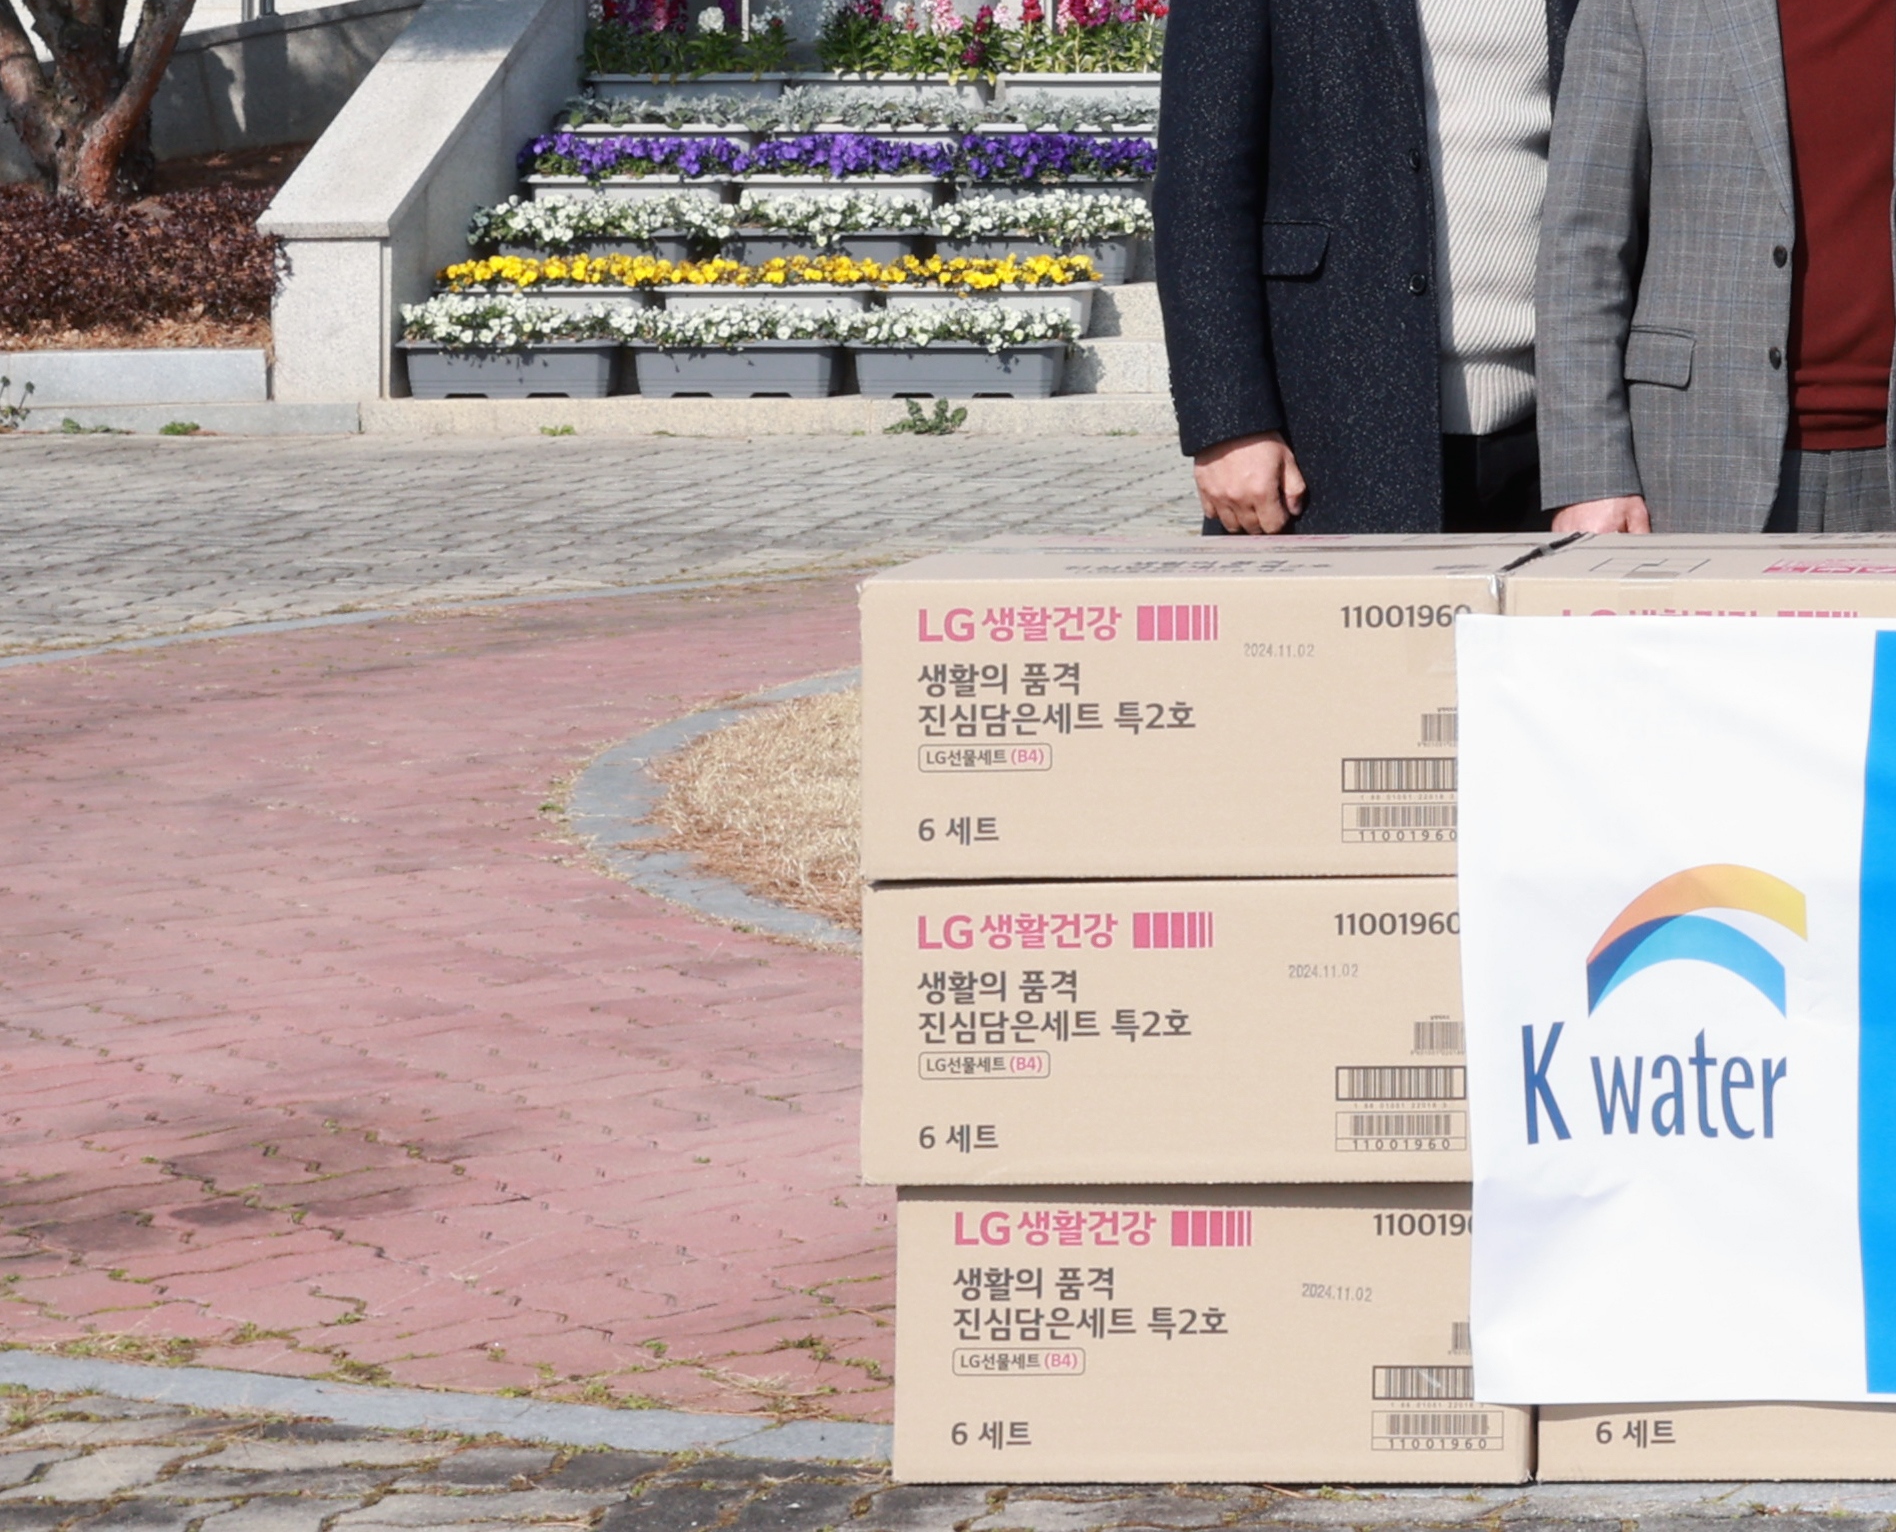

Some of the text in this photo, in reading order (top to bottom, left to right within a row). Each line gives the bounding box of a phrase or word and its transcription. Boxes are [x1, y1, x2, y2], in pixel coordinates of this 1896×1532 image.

[918, 662, 1080, 698] 생활의 품격
[918, 702, 1196, 738] 진심담은세트 특2호
[918, 817, 999, 846] 6 세트
[1360, 830, 1457, 842] 11001960
[918, 969, 1077, 1005] 생활의 품격
[918, 1008, 1192, 1045] 진심담은세트 특2호
[919, 1124, 999, 1154] 6 세트
[1353, 1139, 1450, 1150] 11001960
[1373, 1213, 1472, 1236] 110019
[953, 1267, 1114, 1302] 생활의 품격
[953, 1307, 1229, 1342] 진심담은세트 특2호
[951, 1420, 1032, 1451] 6 세트
[1389, 1439, 1487, 1450] 11001960
[1596, 1418, 1676, 1449] 6 세트
